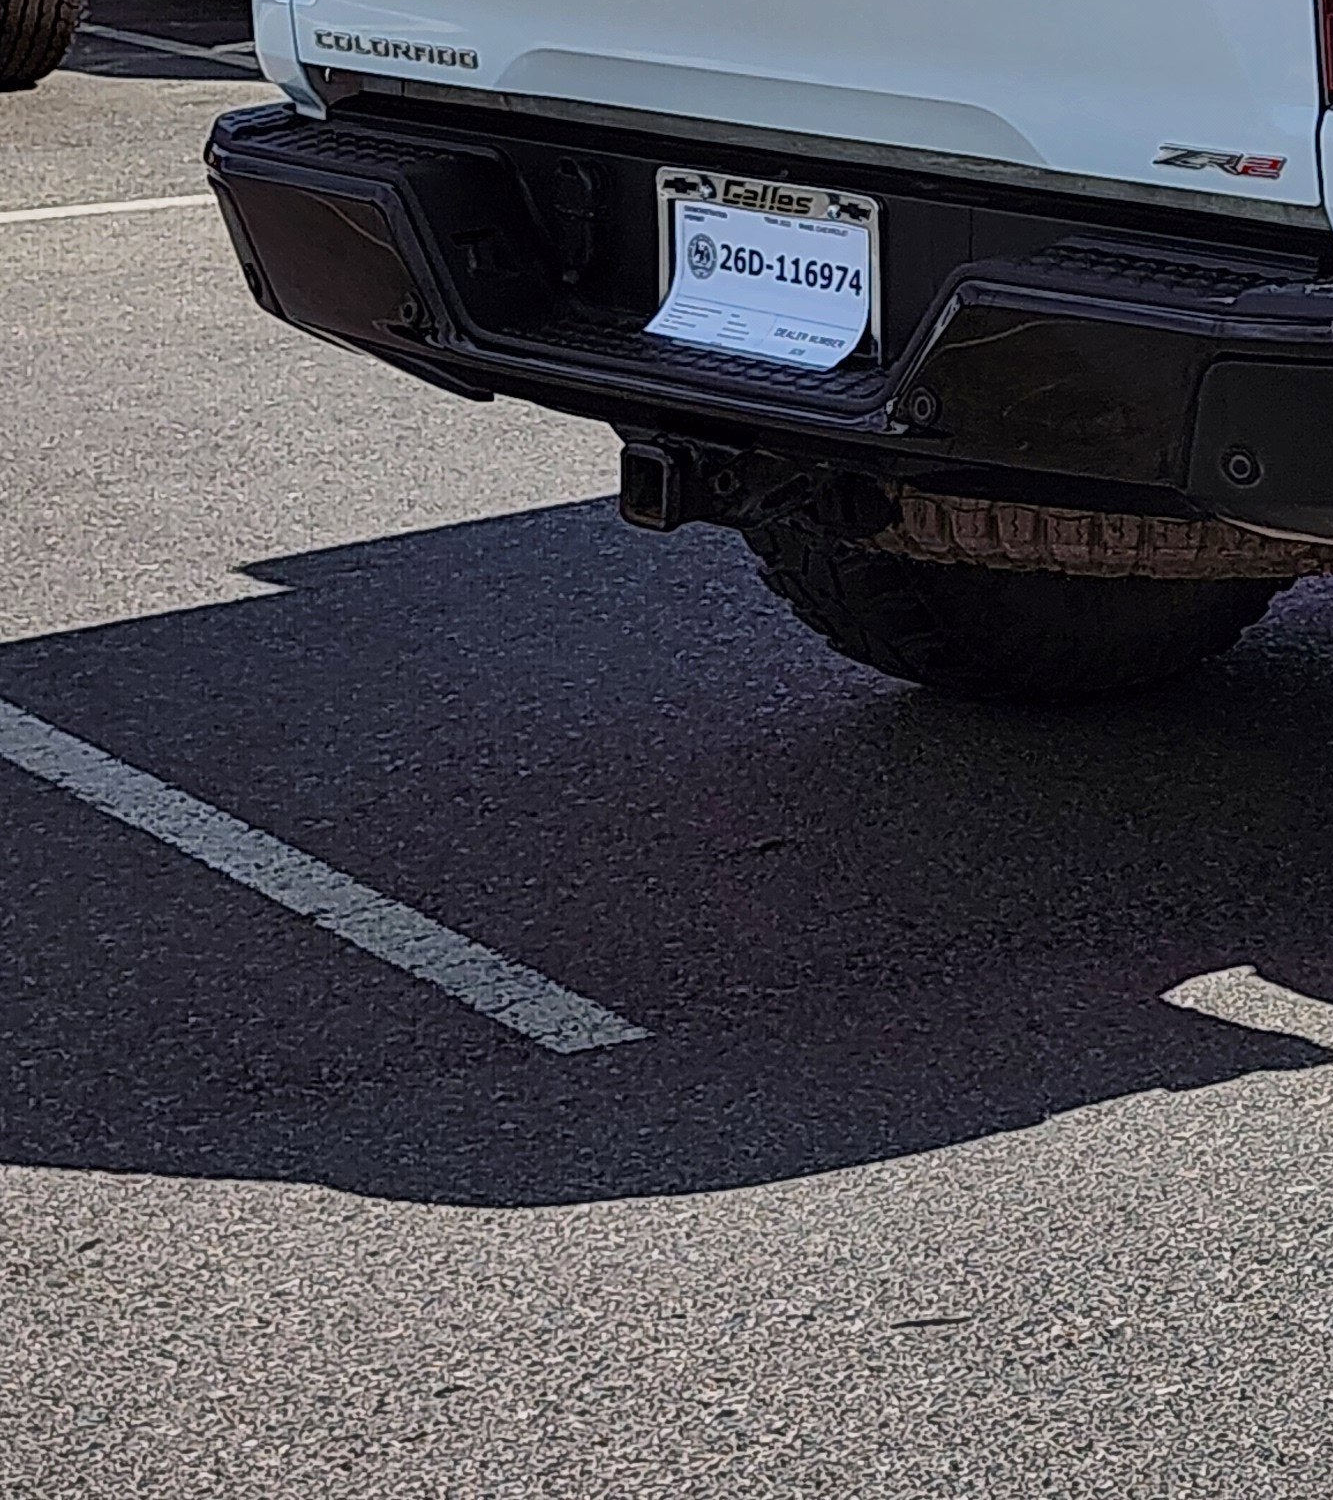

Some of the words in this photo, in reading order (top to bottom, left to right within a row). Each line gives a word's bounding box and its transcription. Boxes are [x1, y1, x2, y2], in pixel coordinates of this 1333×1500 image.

[314, 29, 479, 70] COLORADO
[1152, 142, 1288, 180] ZR2
[721, 179, 814, 215] Galles
[719, 243, 863, 297] 26D-116974
